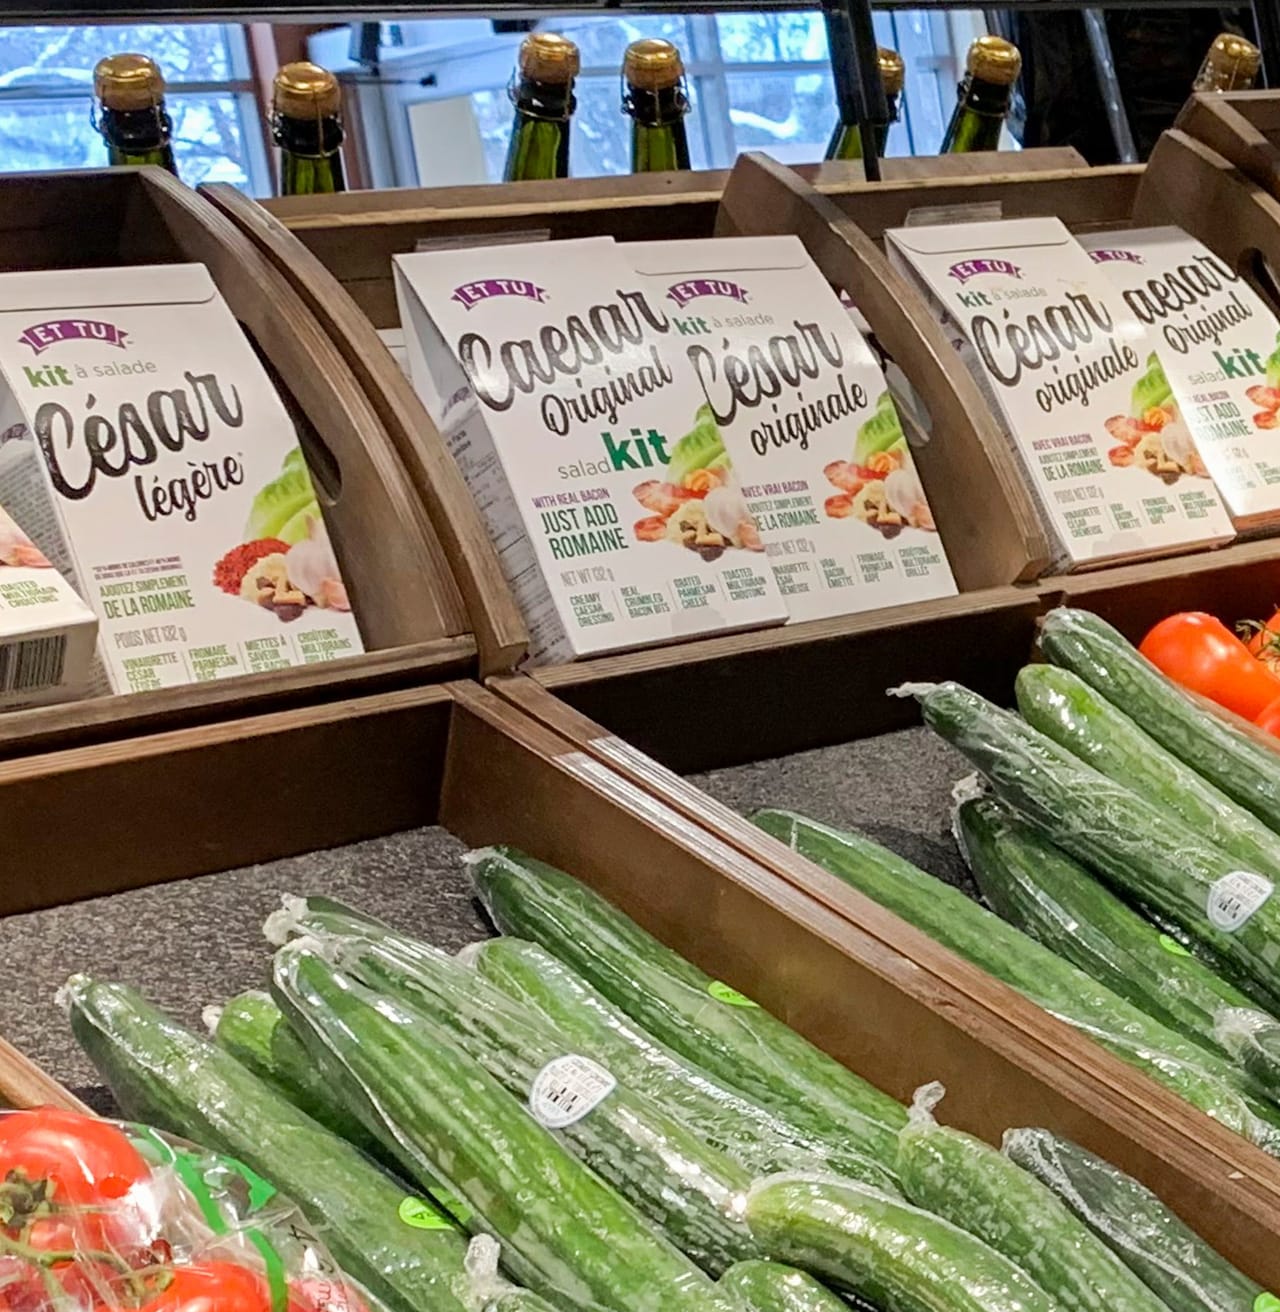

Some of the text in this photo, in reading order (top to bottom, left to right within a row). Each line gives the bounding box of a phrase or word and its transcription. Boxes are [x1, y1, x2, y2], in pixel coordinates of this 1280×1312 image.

[959, 260, 1009, 281] ET TU
[468, 281, 527, 300] ET TU
[679, 281, 731, 299] ET TU
[956, 290, 993, 309] kit
[1122, 255, 1240, 326] aesar
[37, 321, 108, 343] ET TU
[671, 314, 712, 336] kit
[971, 292, 1114, 387] César
[1163, 292, 1253, 355] Original
[458, 289, 670, 411] Caesar
[1212, 348, 1267, 379] kit
[22, 364, 72, 388] kit
[93, 358, 157, 379] salade
[686, 320, 845, 427] César
[1036, 338, 1139, 413] originale
[542, 344, 672, 437] Original
[750, 374, 868, 456] originale
[33, 371, 244, 501] César
[557, 428, 672, 480] salad kit
[134, 451, 244, 522] légère
[540, 503, 618, 534] JUST ADD
[767, 515, 778, 530] LA
[779, 508, 820, 528] ROMAINE
[549, 527, 628, 560] ROMAINE
[103, 590, 195, 619] DE LA ROMAINE
